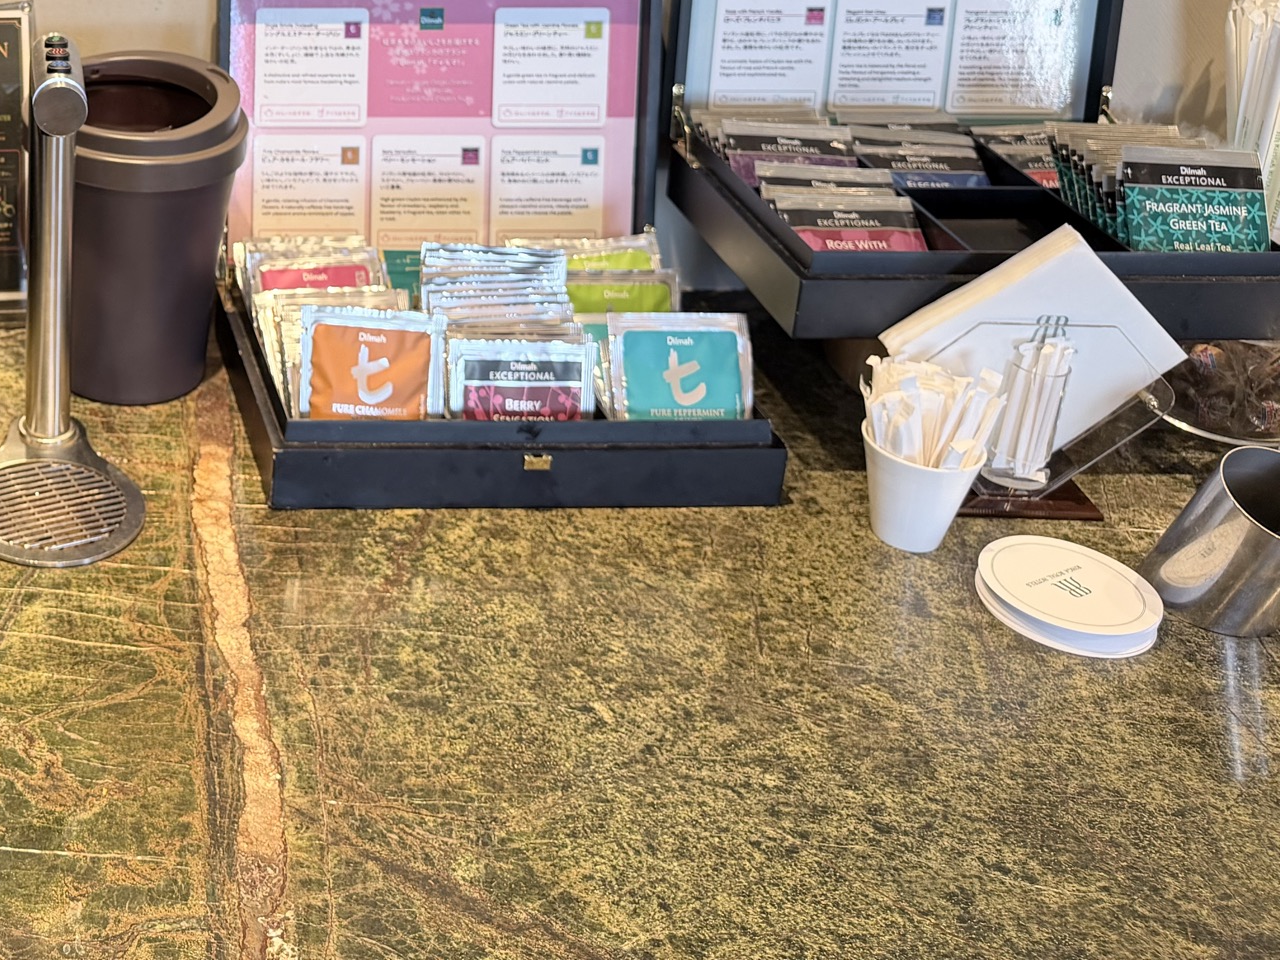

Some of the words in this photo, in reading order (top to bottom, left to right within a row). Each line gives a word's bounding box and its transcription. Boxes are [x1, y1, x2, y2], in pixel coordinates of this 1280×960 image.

[761, 143, 821, 155] EXCEPTIONAL
[891, 161, 951, 171] EXCEPTIONAL
[1180, 166, 1207, 176] Dilmah
[1161, 175, 1227, 187] EXCEPTIONAL
[1145, 200, 1202, 214] FRAGRANT
[1204, 202, 1248, 217] JASMINE
[817, 219, 882, 228] EXCEPTIONAL
[1170, 219, 1207, 231] GREEN
[1209, 220, 1229, 232] TEA
[825, 240, 855, 250] ROSE
[857, 240, 888, 250] WITH
[1173, 241, 1194, 251] Real
[1195, 242, 1214, 251] Leaf
[1216, 243, 1232, 252] Tea
[358, 332, 387, 344] Dilmah
[666, 335, 694, 346] Dilmah
[489, 371, 555, 381] EXCEPTIONAL
[505, 398, 542, 412] BERRY
[650, 408, 672, 417] PURE
[673, 408, 725, 417] PEPPERMINT
